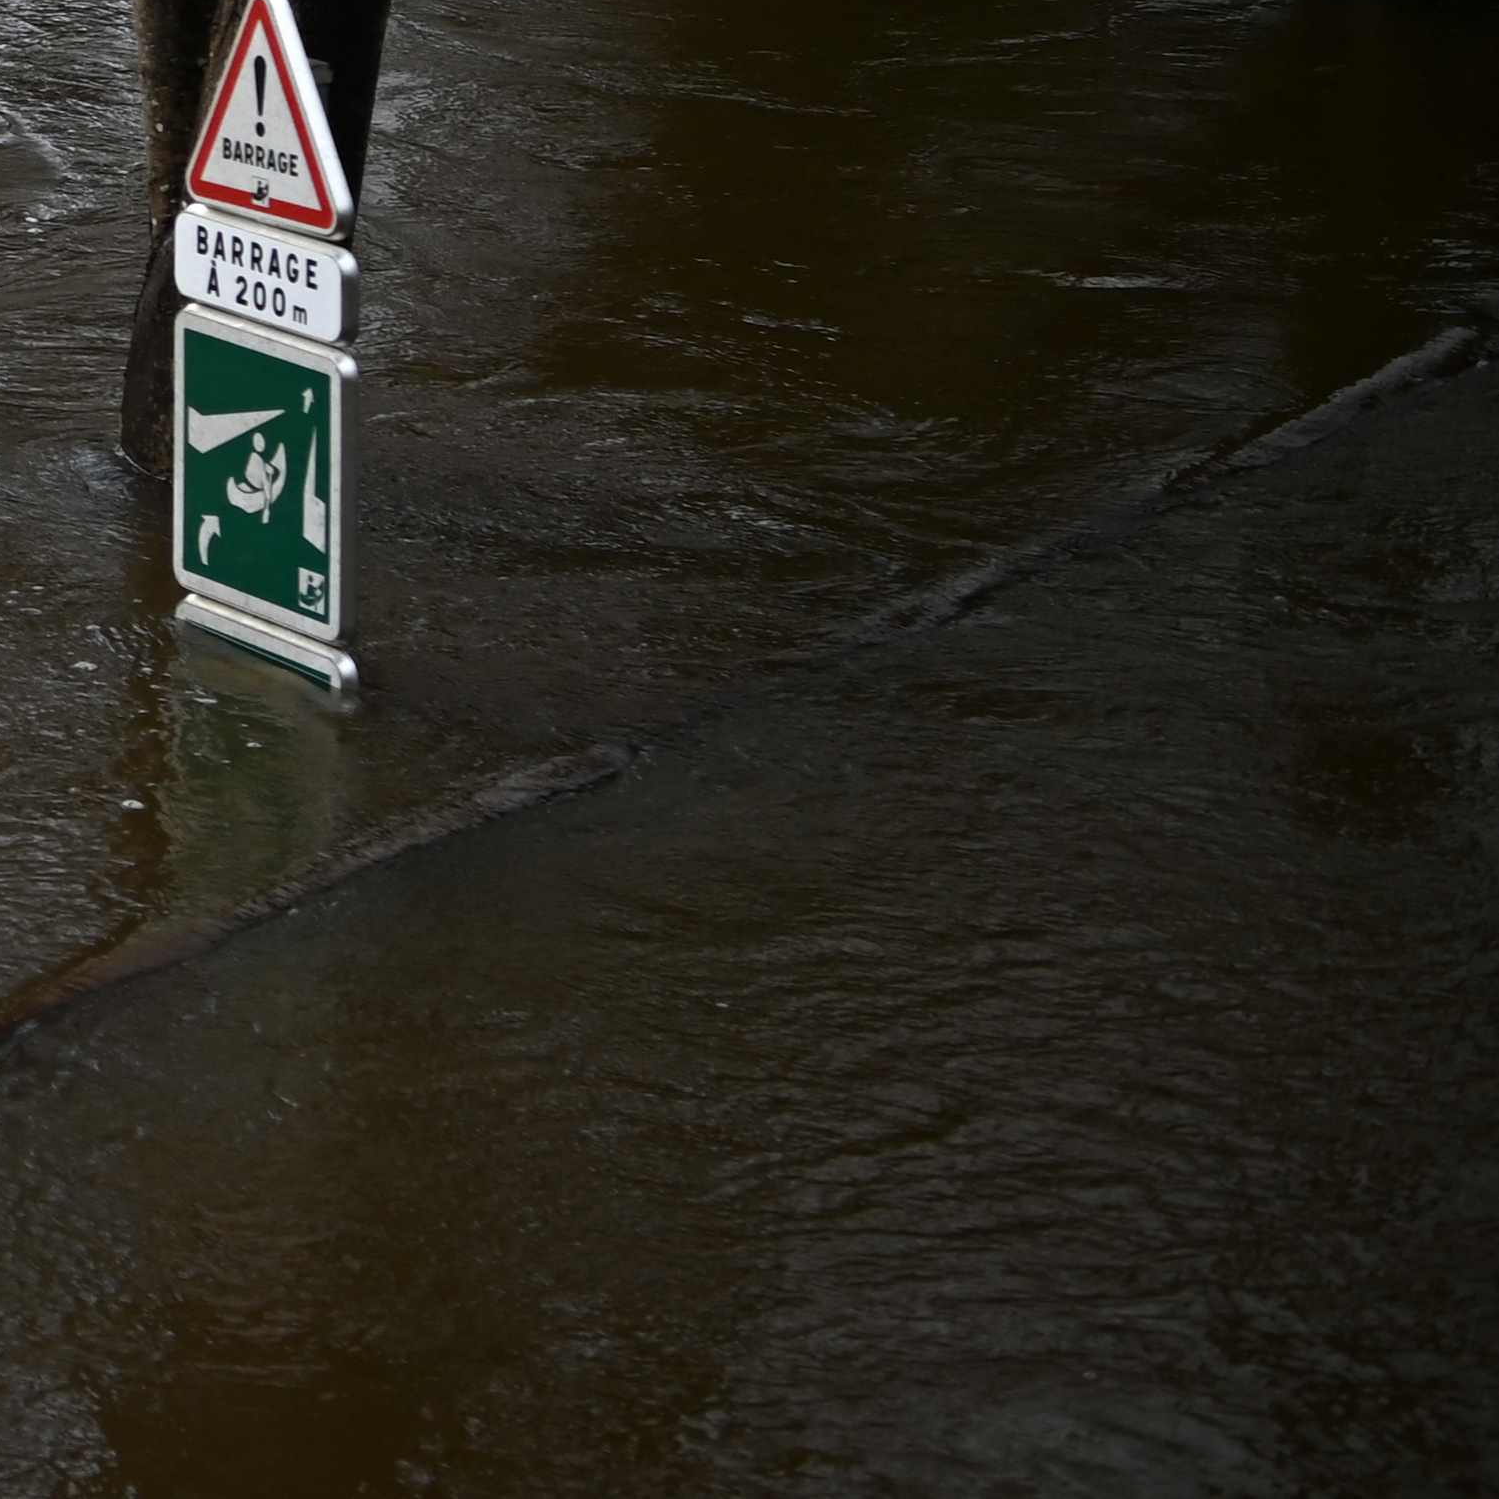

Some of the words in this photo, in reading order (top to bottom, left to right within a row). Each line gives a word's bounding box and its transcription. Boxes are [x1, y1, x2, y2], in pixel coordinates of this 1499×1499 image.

[222, 137, 299, 177] BARRAGE
[197, 225, 319, 291] BARRAGE
[207, 260, 220, 298] À
